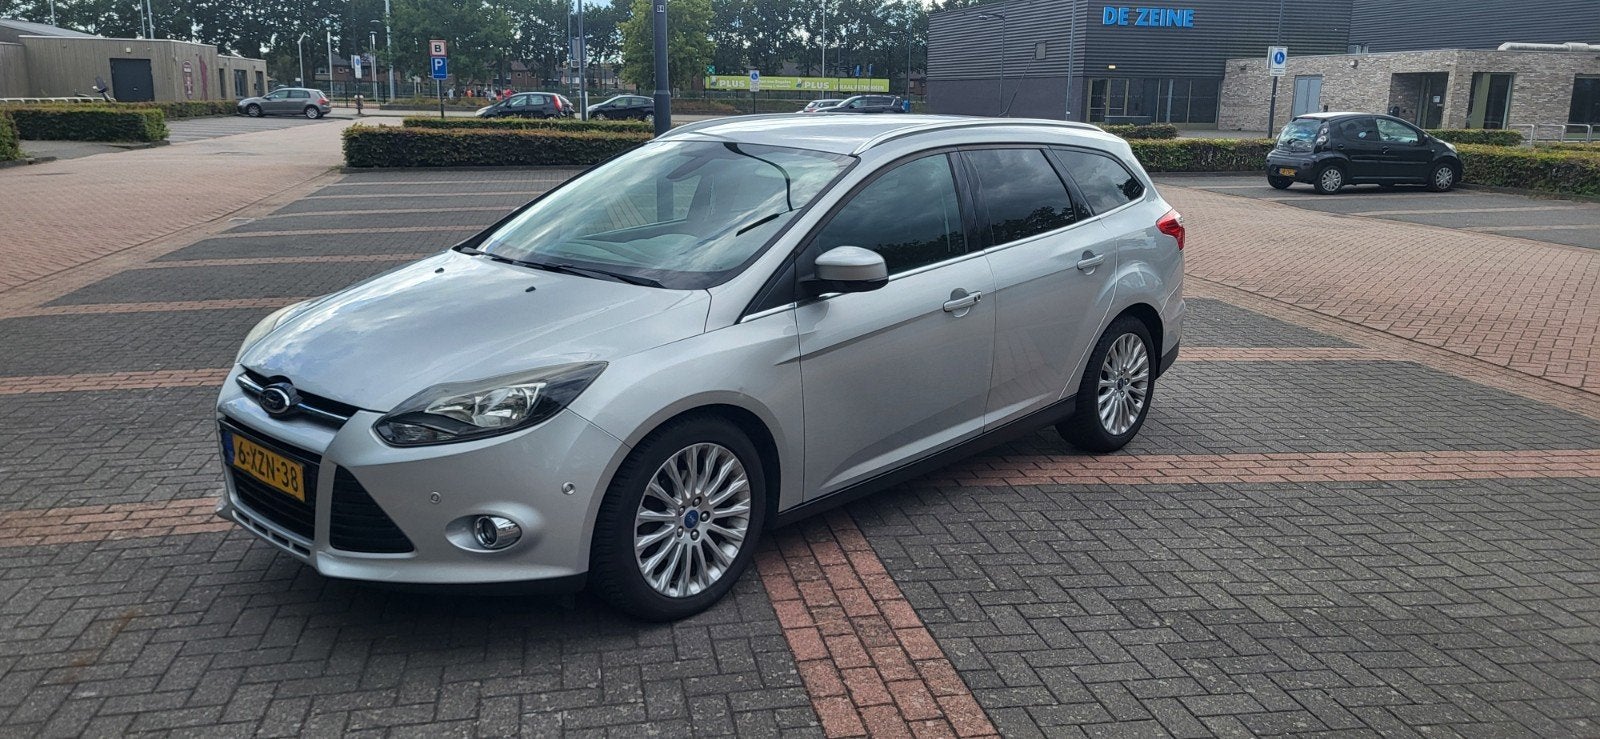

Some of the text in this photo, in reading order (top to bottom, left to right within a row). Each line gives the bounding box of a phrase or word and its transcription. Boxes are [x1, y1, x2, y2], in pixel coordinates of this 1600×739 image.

[1102, 6, 1195, 28] DE ZEINE
[434, 44, 442, 53] B
[434, 58, 444, 71] P
[719, 79, 745, 88] PLUS
[804, 81, 830, 89] PLUS
[238, 441, 299, 493] 6-XZN-38
